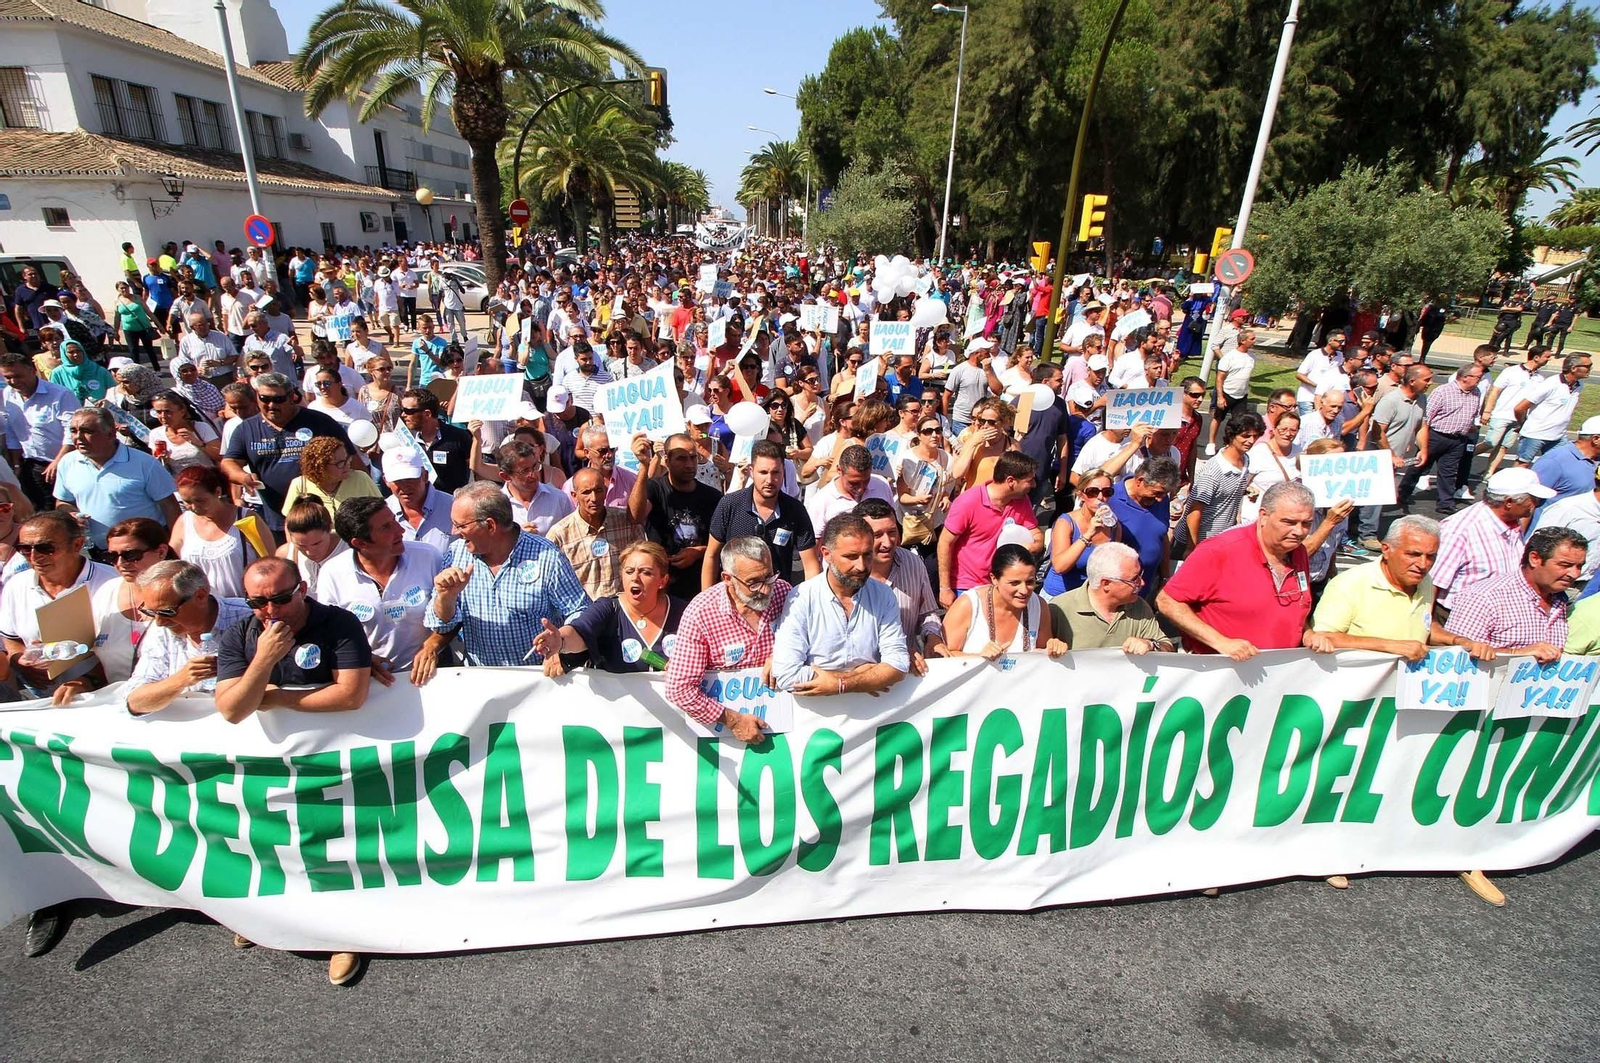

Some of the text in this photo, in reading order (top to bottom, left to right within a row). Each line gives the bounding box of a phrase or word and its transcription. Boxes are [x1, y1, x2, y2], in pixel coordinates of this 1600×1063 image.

[697, 232, 724, 248] AGUA
[873, 323, 910, 336] ¡¡AGUA
[881, 338, 906, 350] YA!!
[463, 379, 515, 396] ¡¡AGUA
[607, 376, 668, 412] ¡¡AGUA
[471, 398, 506, 416] YA!!
[1112, 391, 1174, 408] ¡¡AGUA
[623, 405, 664, 434] YA!!
[1126, 409, 1166, 427] YA!!
[1308, 455, 1379, 478] ¡¡AGUA
[1325, 478, 1372, 499] YA!!
[1510, 661, 1597, 683] ¡¡AGUA
[1420, 679, 1470, 707] YA!!
[1520, 686, 1579, 709] YA!!
[111, 722, 535, 898] DEFENSA
[562, 725, 664, 880] DE
[696, 728, 845, 880] LOS
[869, 676, 1252, 866] REGADÍOS
[1253, 694, 1397, 827] DEL
